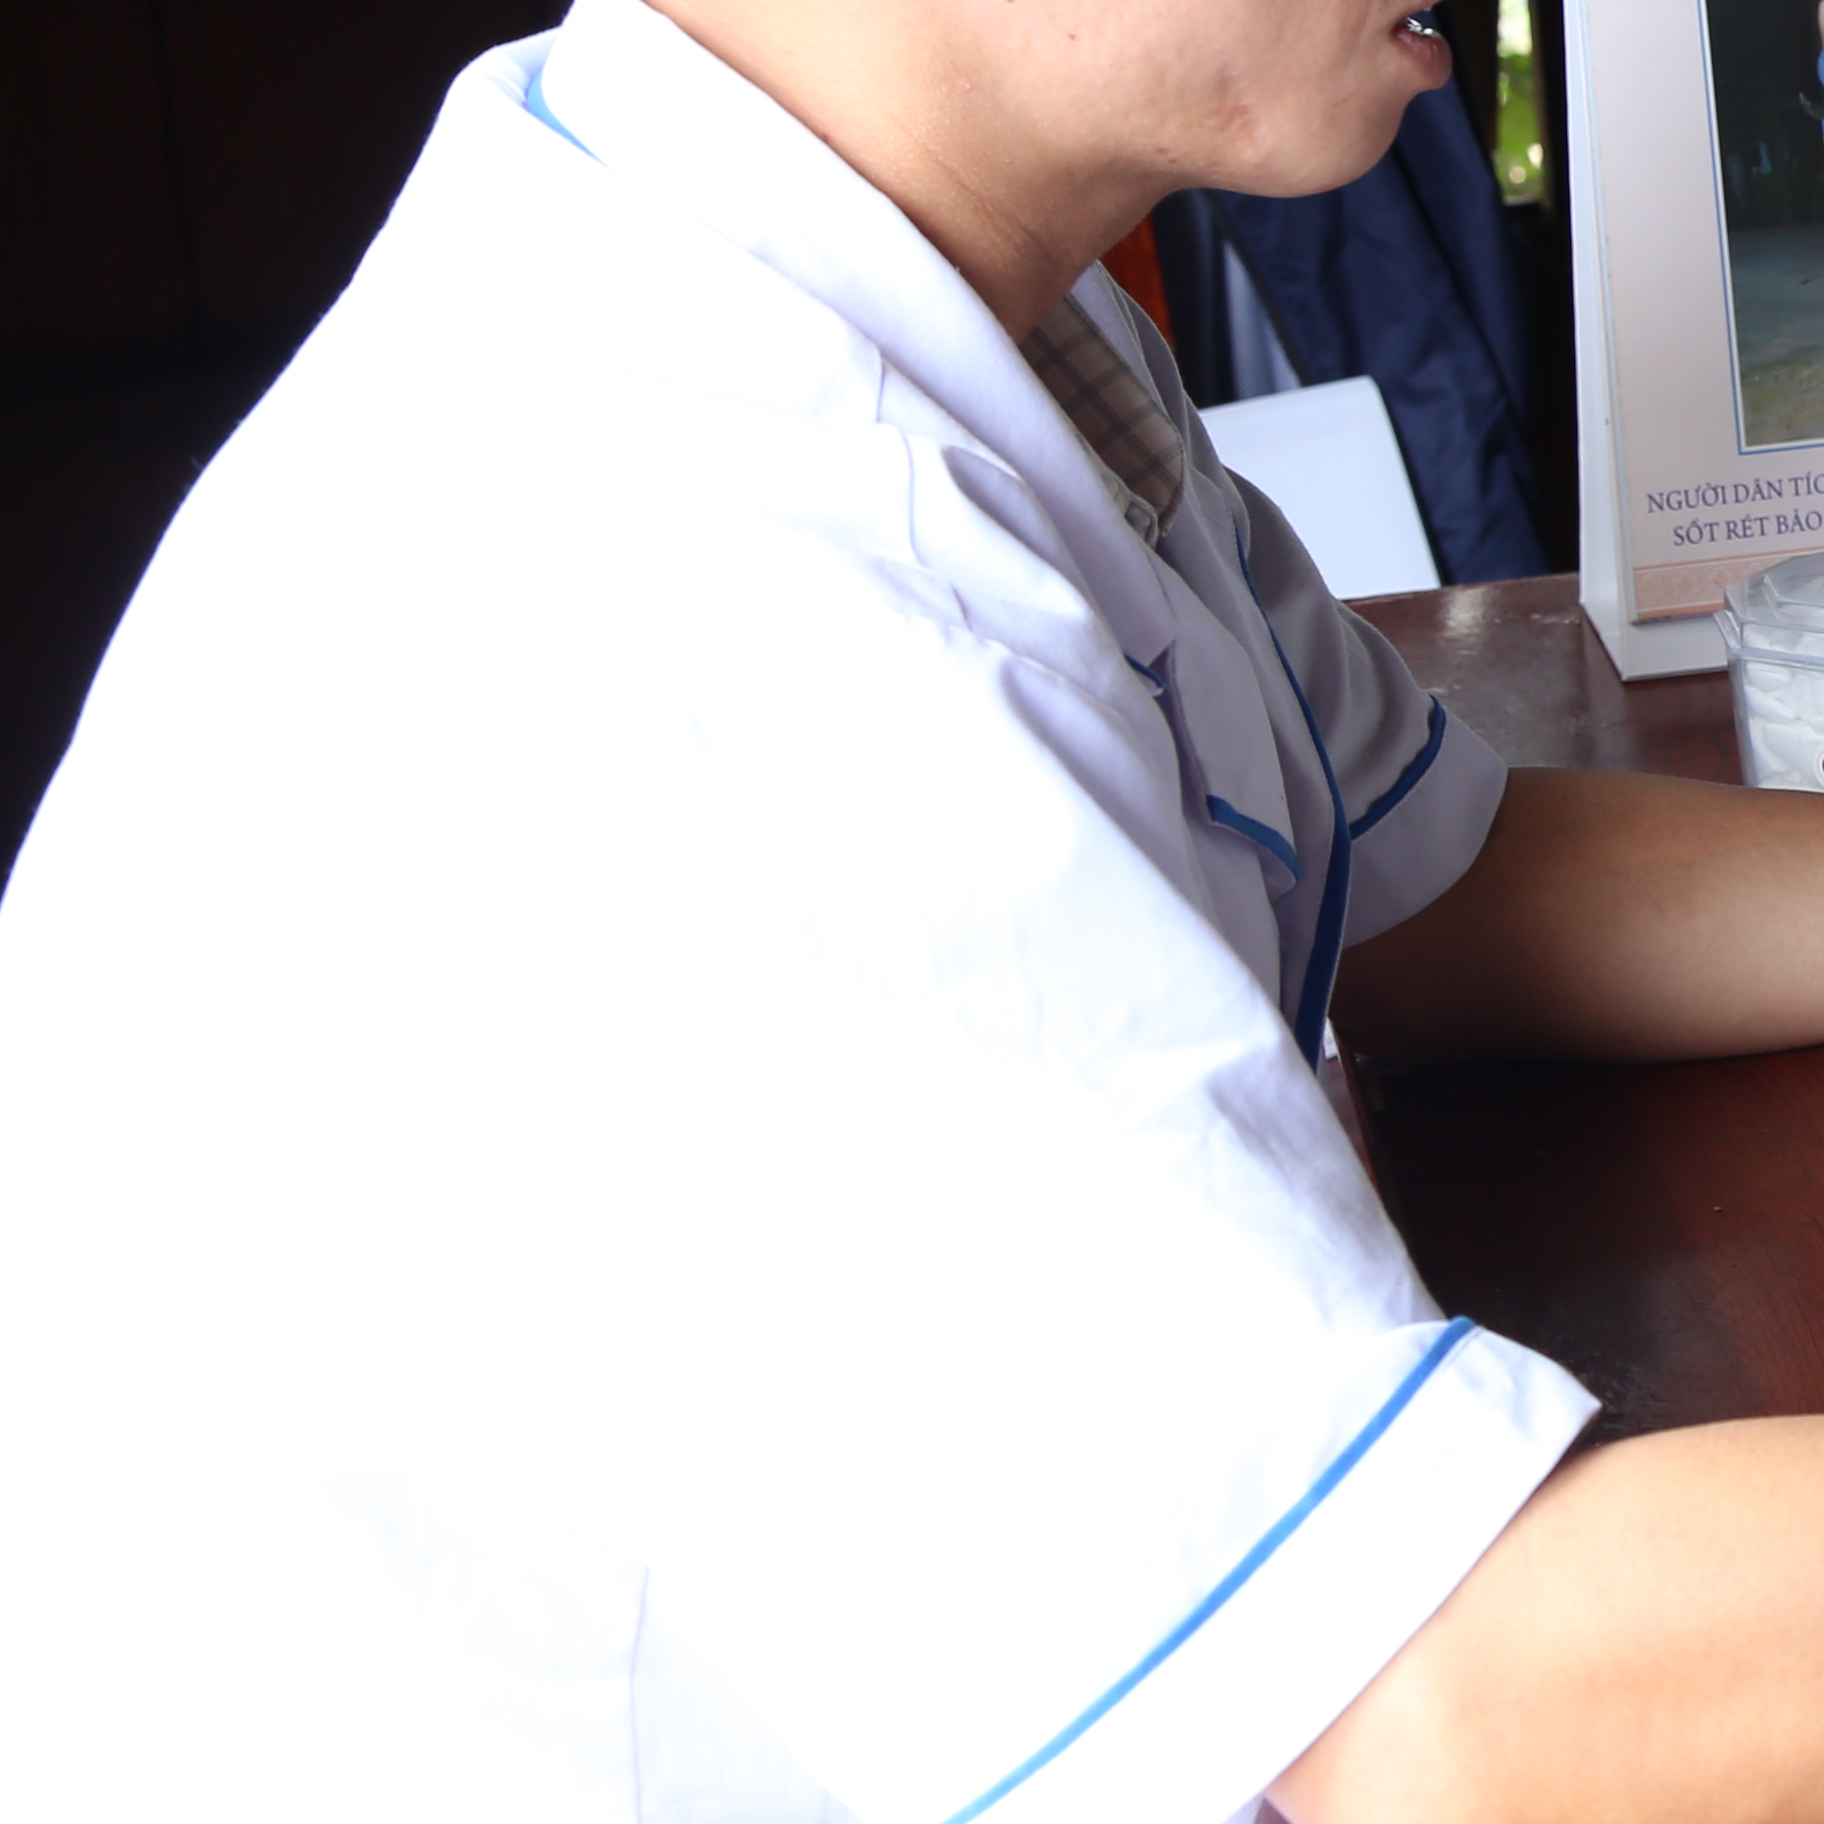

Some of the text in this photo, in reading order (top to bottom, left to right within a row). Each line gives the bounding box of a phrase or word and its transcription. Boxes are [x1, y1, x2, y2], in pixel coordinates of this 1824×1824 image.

[1647, 481, 1728, 513] NGƯỜI
[1733, 478, 1784, 504] DÂN
[1673, 520, 1719, 547] SỐT
[1726, 514, 1769, 542] RÉT
[1775, 508, 1823, 535] BẢO
